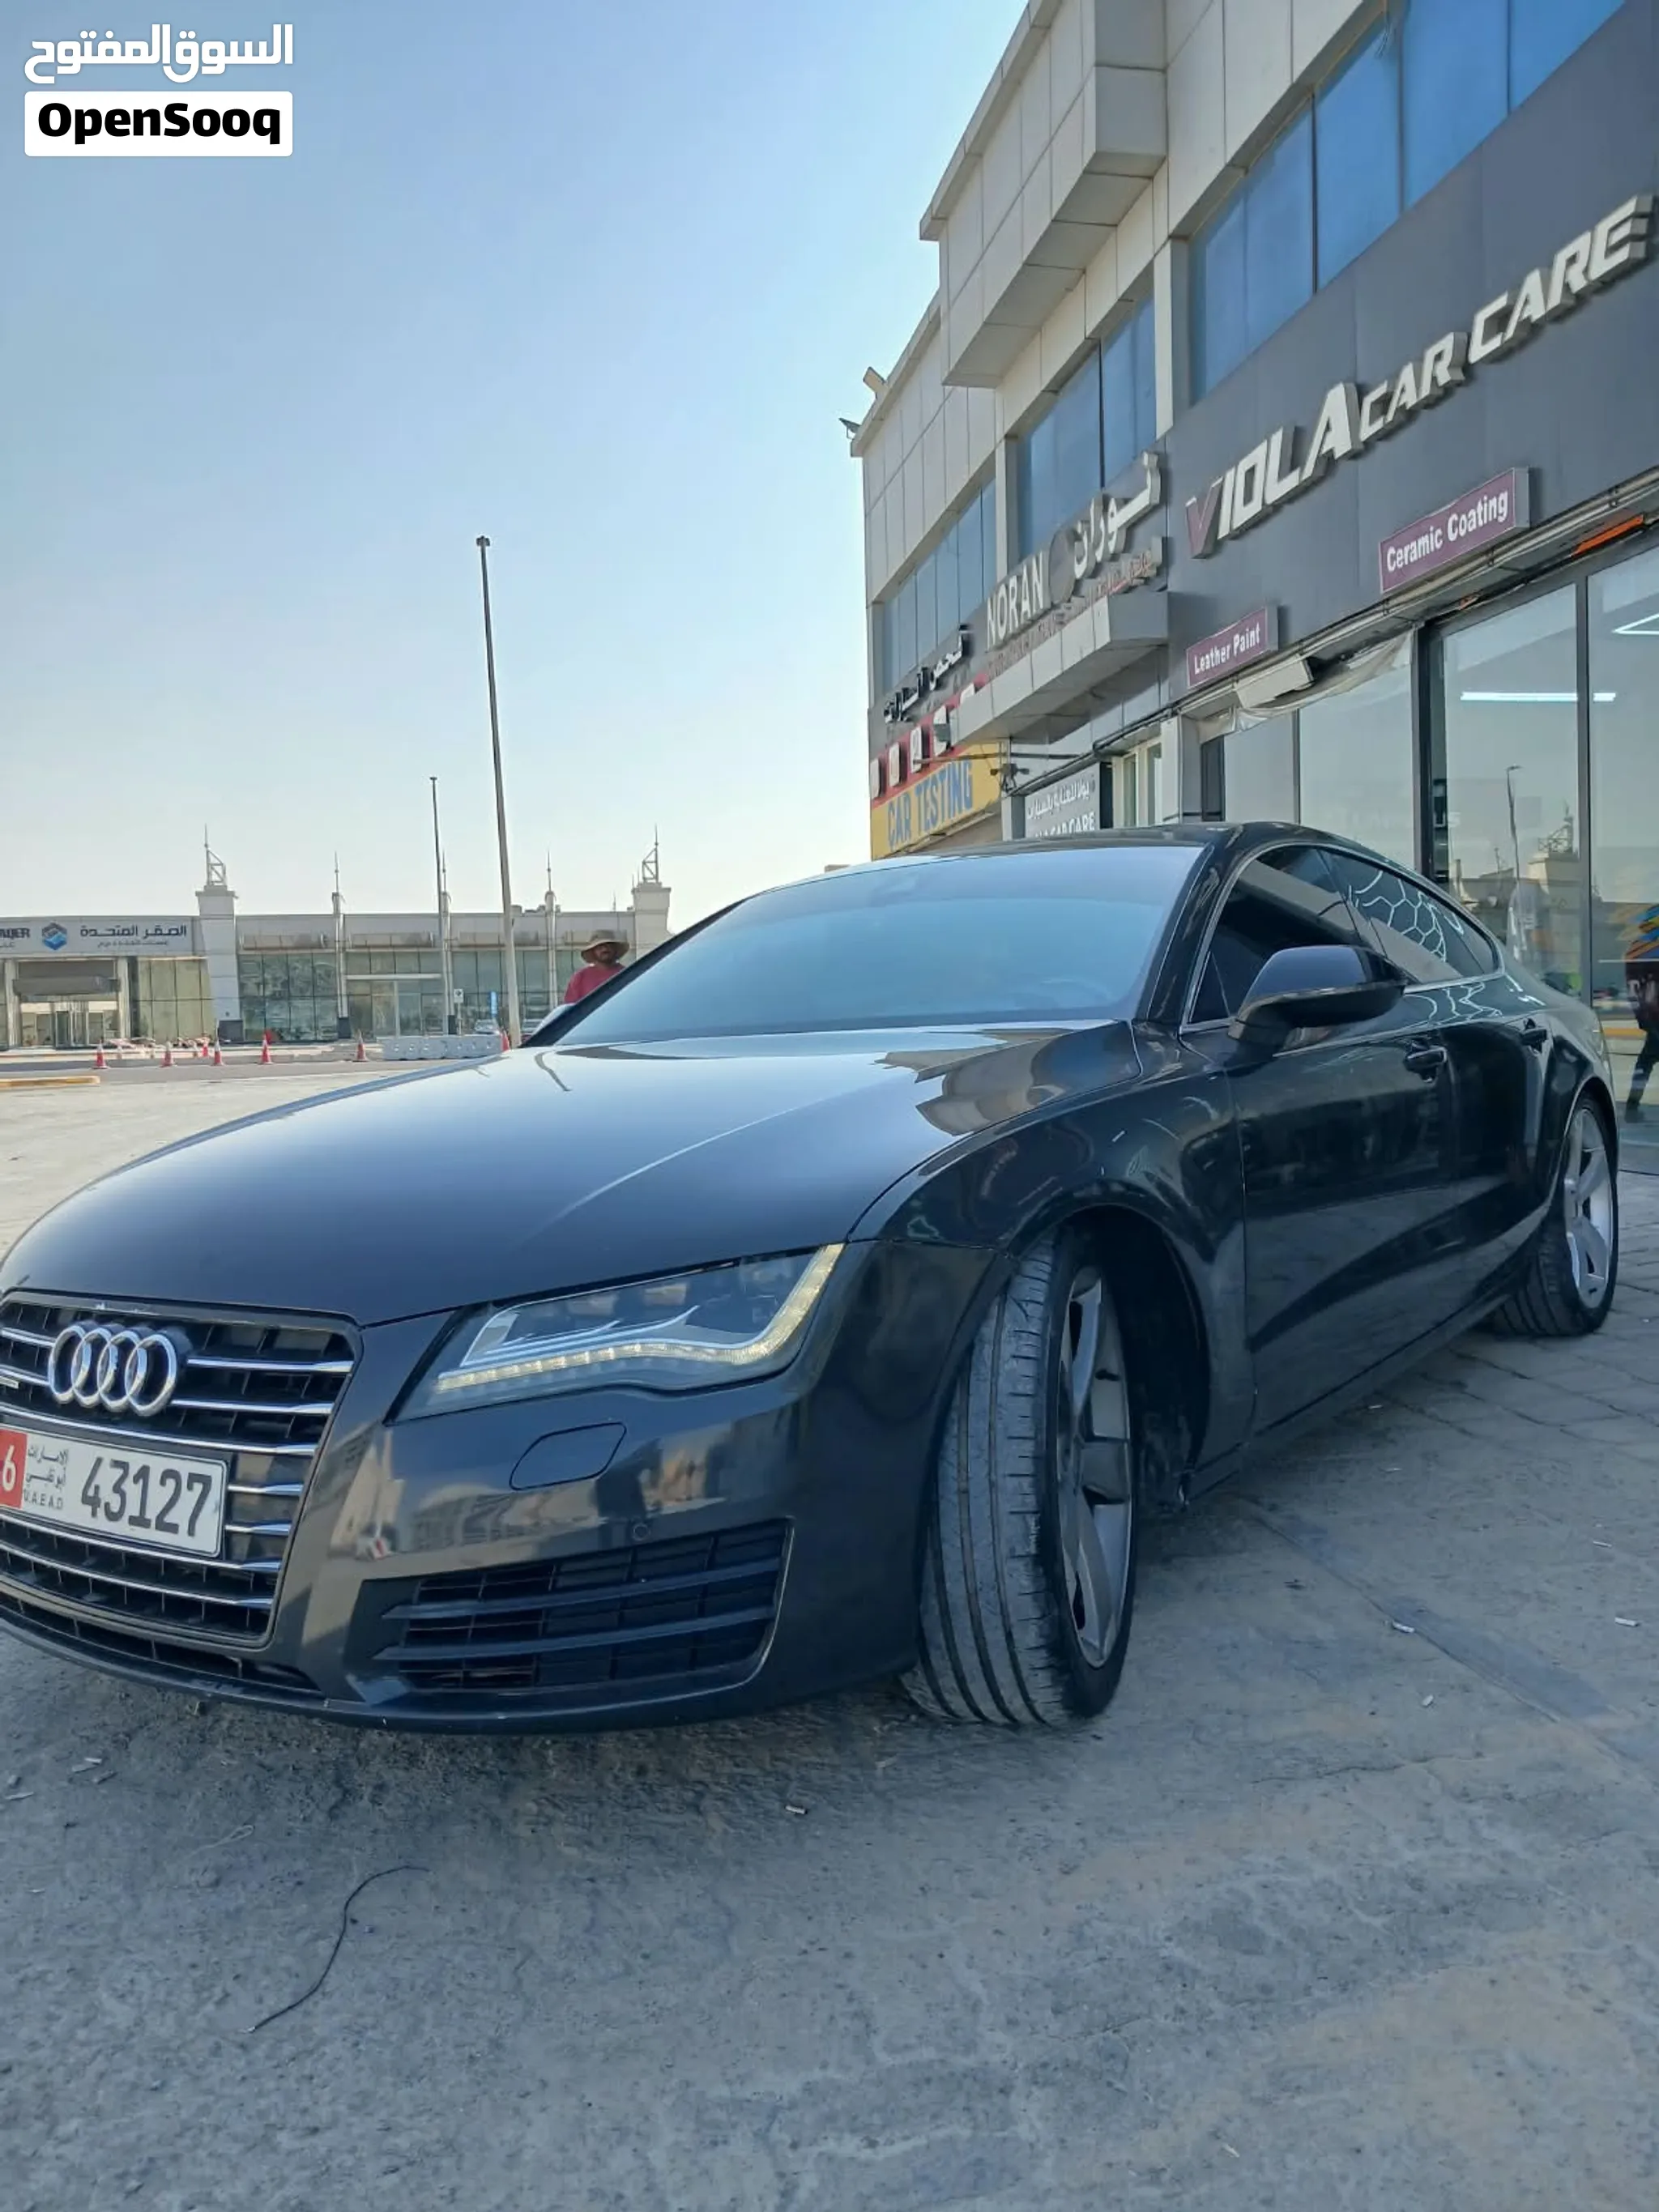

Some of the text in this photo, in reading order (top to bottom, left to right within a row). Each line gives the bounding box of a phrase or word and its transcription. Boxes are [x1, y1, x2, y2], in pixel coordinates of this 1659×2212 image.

[1185, 194, 1646, 558] VIOLA CAR CARE
[1386, 490, 1508, 573] Ceramic Coating
[987, 549, 1045, 652] NORAN
[1194, 621, 1260, 675] Leather Paint
[888, 760, 972, 850] CAR TESTING
[1068, 811, 1095, 833] CARE
[2, 1444, 16, 1492] 6
[81, 1456, 212, 1537] 43127
